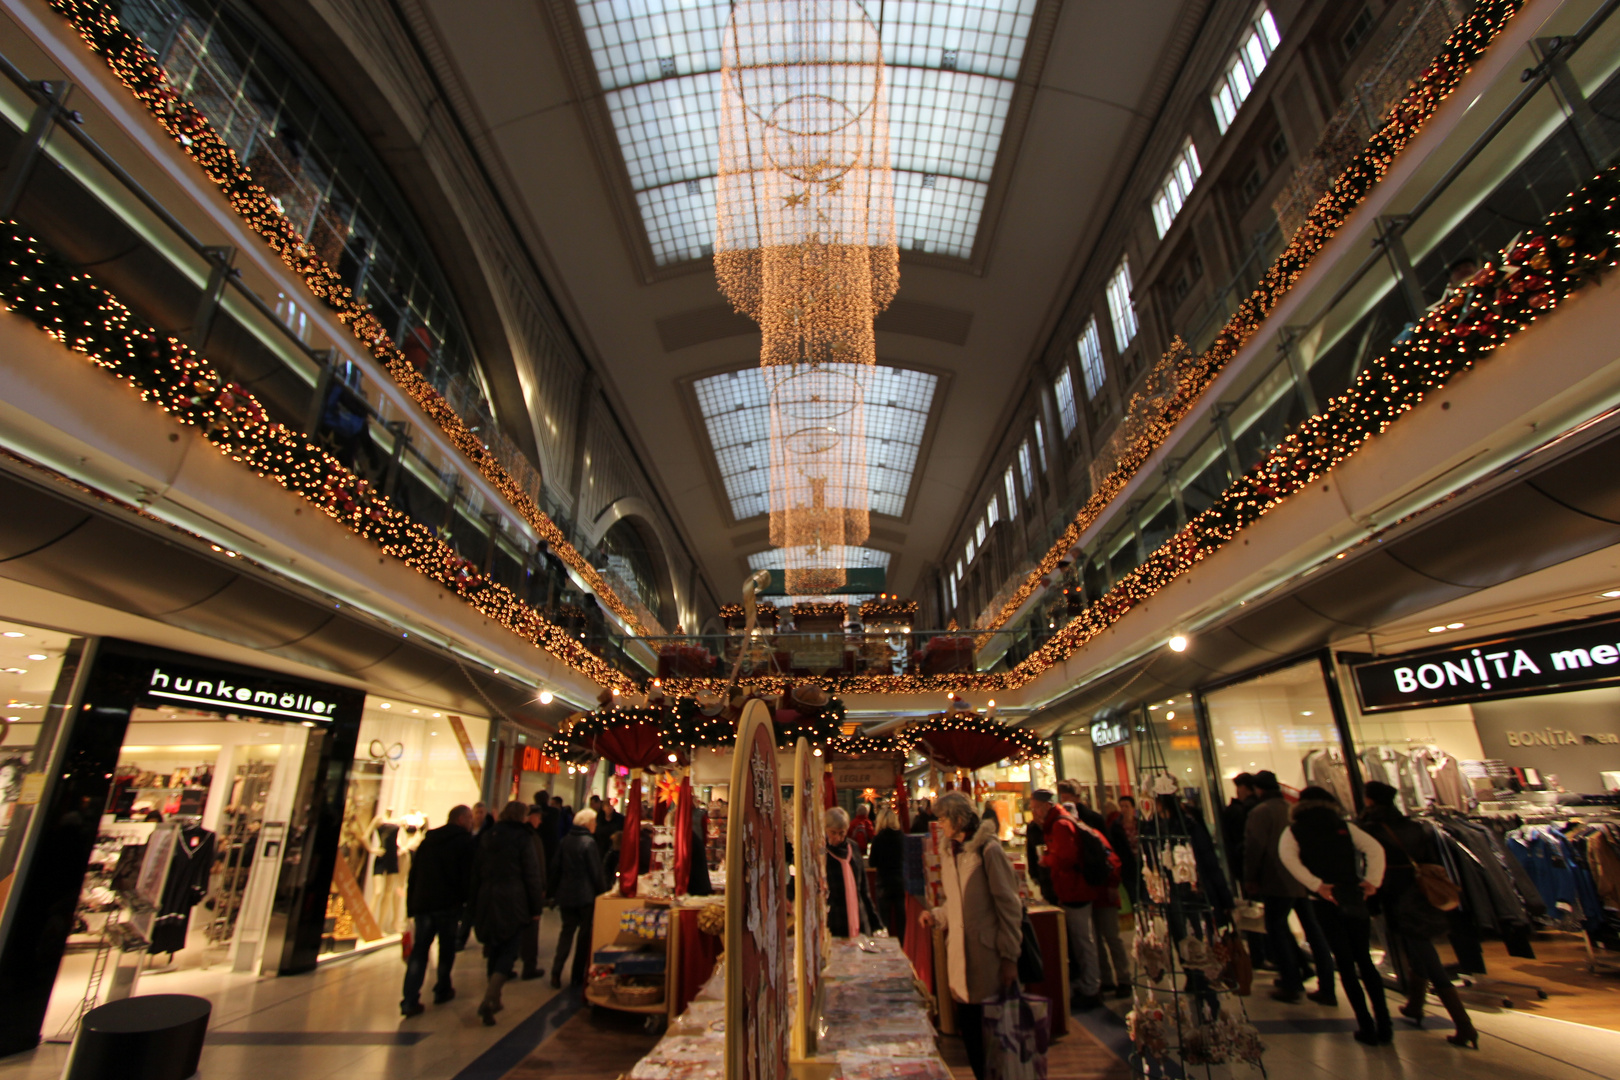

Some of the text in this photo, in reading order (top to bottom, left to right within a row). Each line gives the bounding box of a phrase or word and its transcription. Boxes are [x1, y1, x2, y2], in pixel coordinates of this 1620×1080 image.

[1550, 642, 1620, 671] me
[150, 668, 336, 715] hunkemöller
[839, 774, 871, 783] LEGLER
